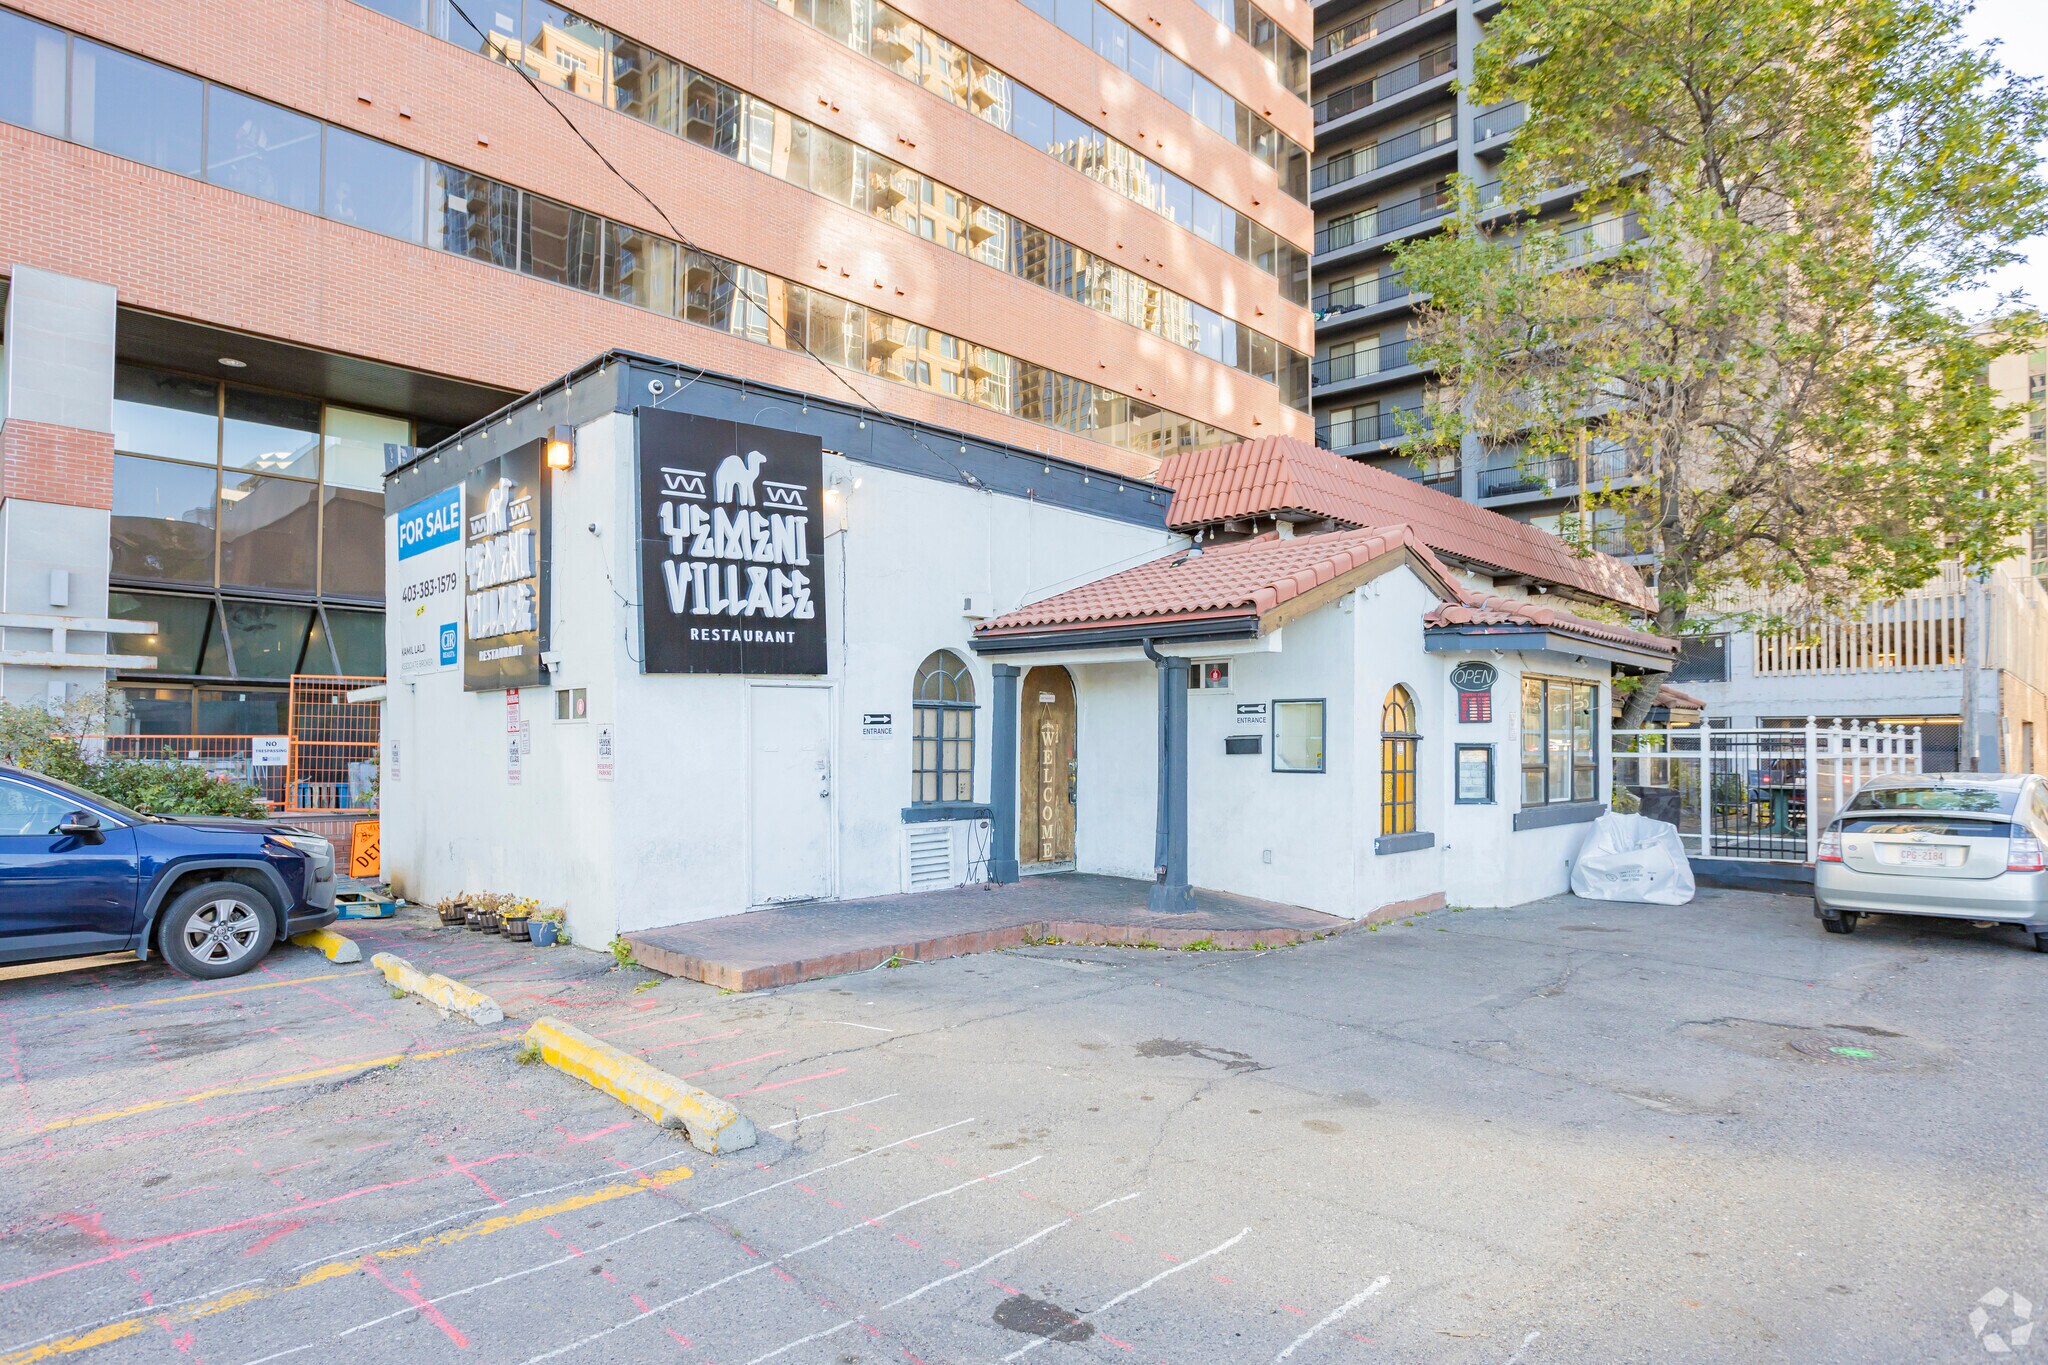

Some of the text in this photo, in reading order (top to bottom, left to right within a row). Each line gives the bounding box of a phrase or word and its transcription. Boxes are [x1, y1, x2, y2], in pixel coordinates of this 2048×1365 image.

[400, 502, 459, 548] FOR SALE
[659, 501, 810, 566] YEMENI
[402, 572, 457, 602] 403-383-1579
[663, 560, 815, 619] VILLAGE
[479, 644, 524, 661] RESTAURANT
[690, 628, 795, 643] RESTAURANT
[1455, 669, 1493, 683] OPEN
[1041, 731, 1055, 858] WELCOME
